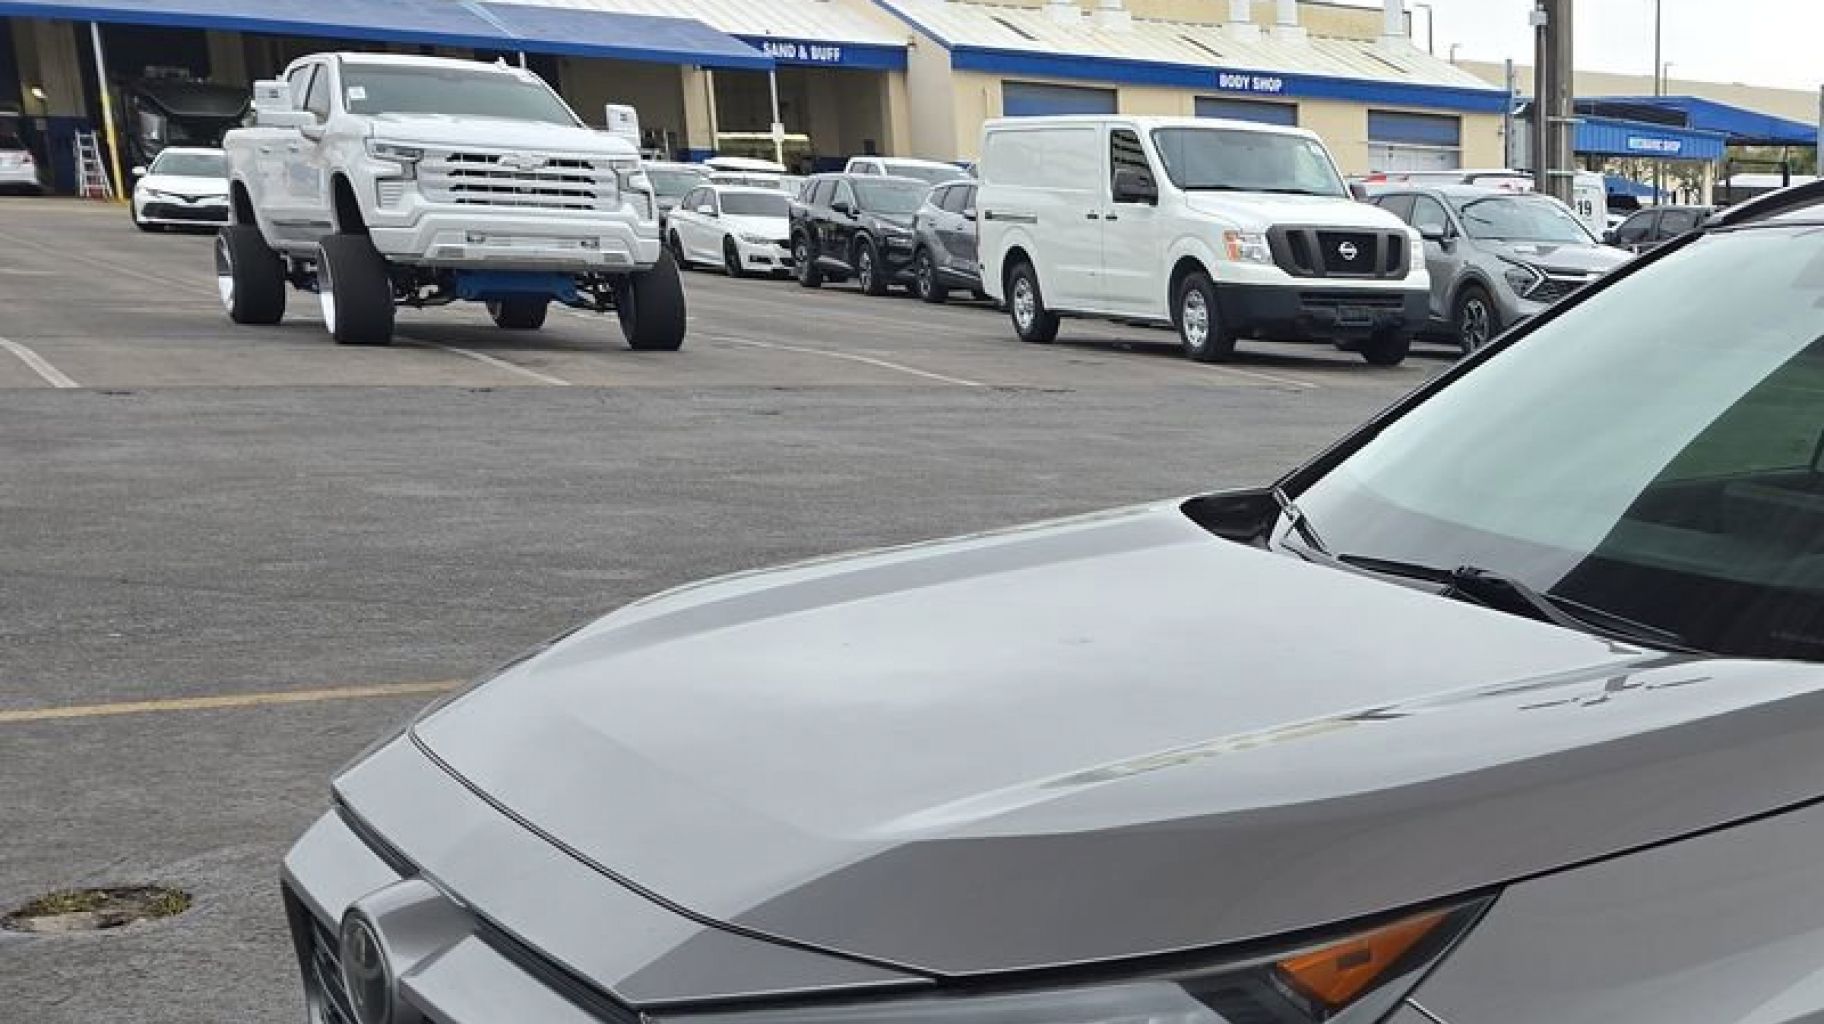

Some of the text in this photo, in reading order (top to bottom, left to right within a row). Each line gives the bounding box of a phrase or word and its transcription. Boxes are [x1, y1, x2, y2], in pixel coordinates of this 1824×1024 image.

[763, 41, 840, 61] SAND & BUFF
[1219, 74, 1282, 92] BODY SHOP
